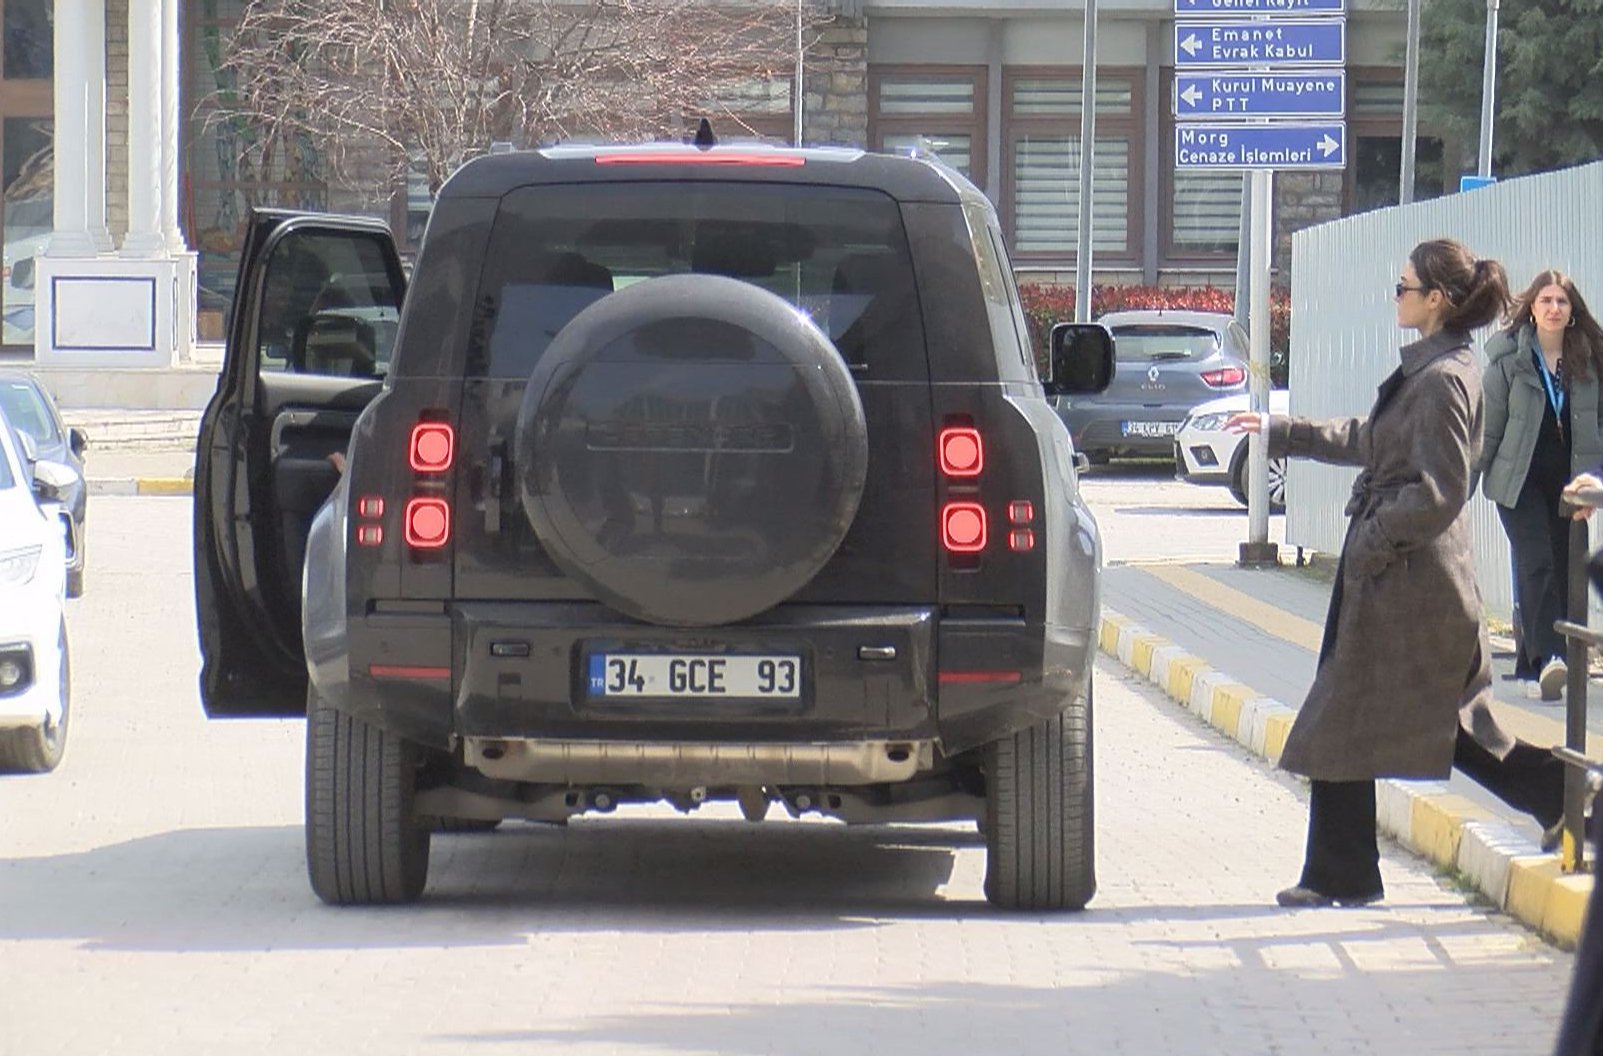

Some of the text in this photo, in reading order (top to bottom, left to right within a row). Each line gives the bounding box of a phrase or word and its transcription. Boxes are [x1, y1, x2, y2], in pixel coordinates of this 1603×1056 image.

[1212, 28, 1282, 42] Emanet
[1212, 44, 1313, 59] Evrak Kabul
[1212, 78, 1335, 96] Kurul Muayene
[1212, 98, 1249, 111] PTT
[1181, 130, 1229, 148] Morg
[1179, 149, 1236, 163] Cenaze
[590, 677, 604, 688] TR
[608, 659, 795, 693] 34 GCE 93
